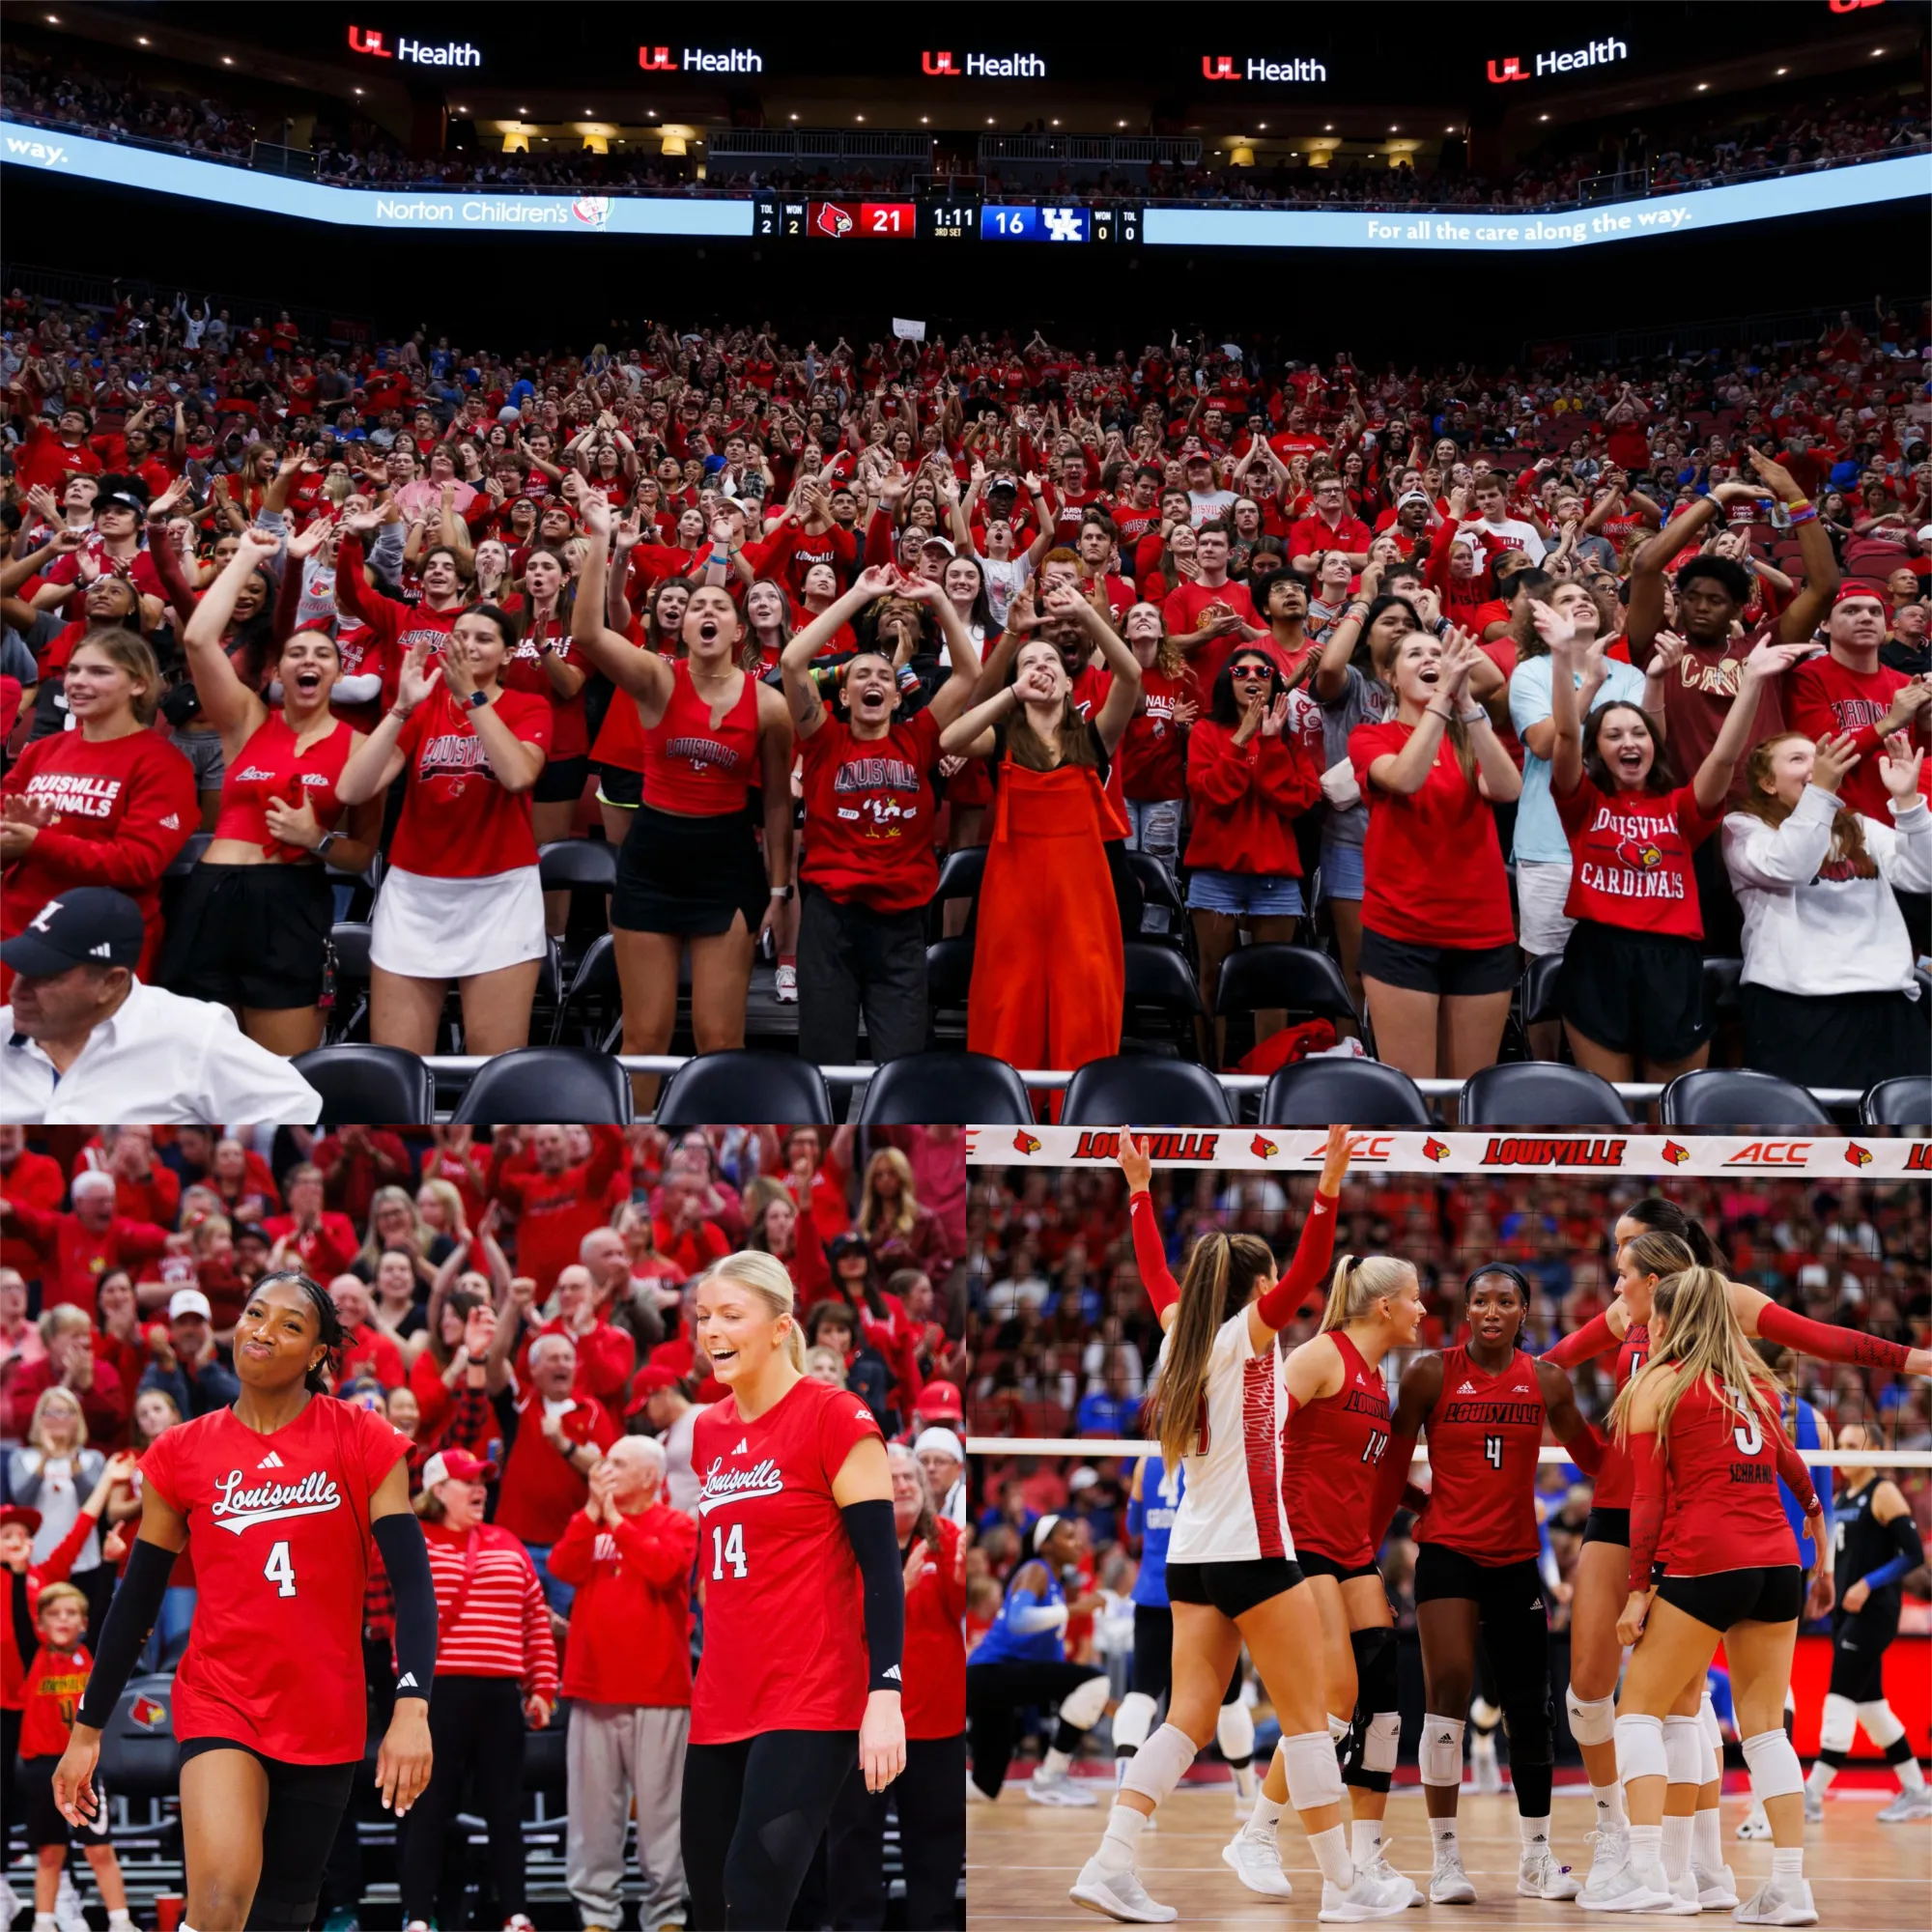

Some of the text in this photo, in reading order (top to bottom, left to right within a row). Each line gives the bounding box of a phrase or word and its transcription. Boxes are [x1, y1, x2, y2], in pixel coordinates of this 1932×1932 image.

[398, 38, 480, 66] Health
[684, 48, 761, 72] Health
[1536, 37, 1627, 76] Health
[967, 53, 1045, 76] Health
[1247, 58, 1326, 81] Health
[6, 137, 69, 166] way.
[376, 199, 568, 224] Norton Children's
[760, 204, 803, 214] TOL WON
[934, 208, 973, 226] 1:11
[1094, 211, 1137, 222] WON TOL
[761, 220, 800, 234] 2 2
[872, 210, 901, 233] 21
[934, 226, 962, 238] 3RD SET
[994, 212, 1024, 234] 16
[1368, 207, 1692, 243] For all the care along the way.
[1097, 227, 1135, 242] 0 0
[667, 737, 739, 771] LOUISVILLE
[1479, 1138, 1628, 1167] LOUISVILLE
[1727, 1143, 1814, 1163] ACC
[1443, 1402, 1541, 1426] LOUISVILLE
[1485, 1433, 1504, 1470] 4
[699, 1456, 783, 1504] Louisville
[212, 1469, 341, 1520] Louisville
[711, 1522, 749, 1581] 14
[262, 1540, 298, 1599] 4
